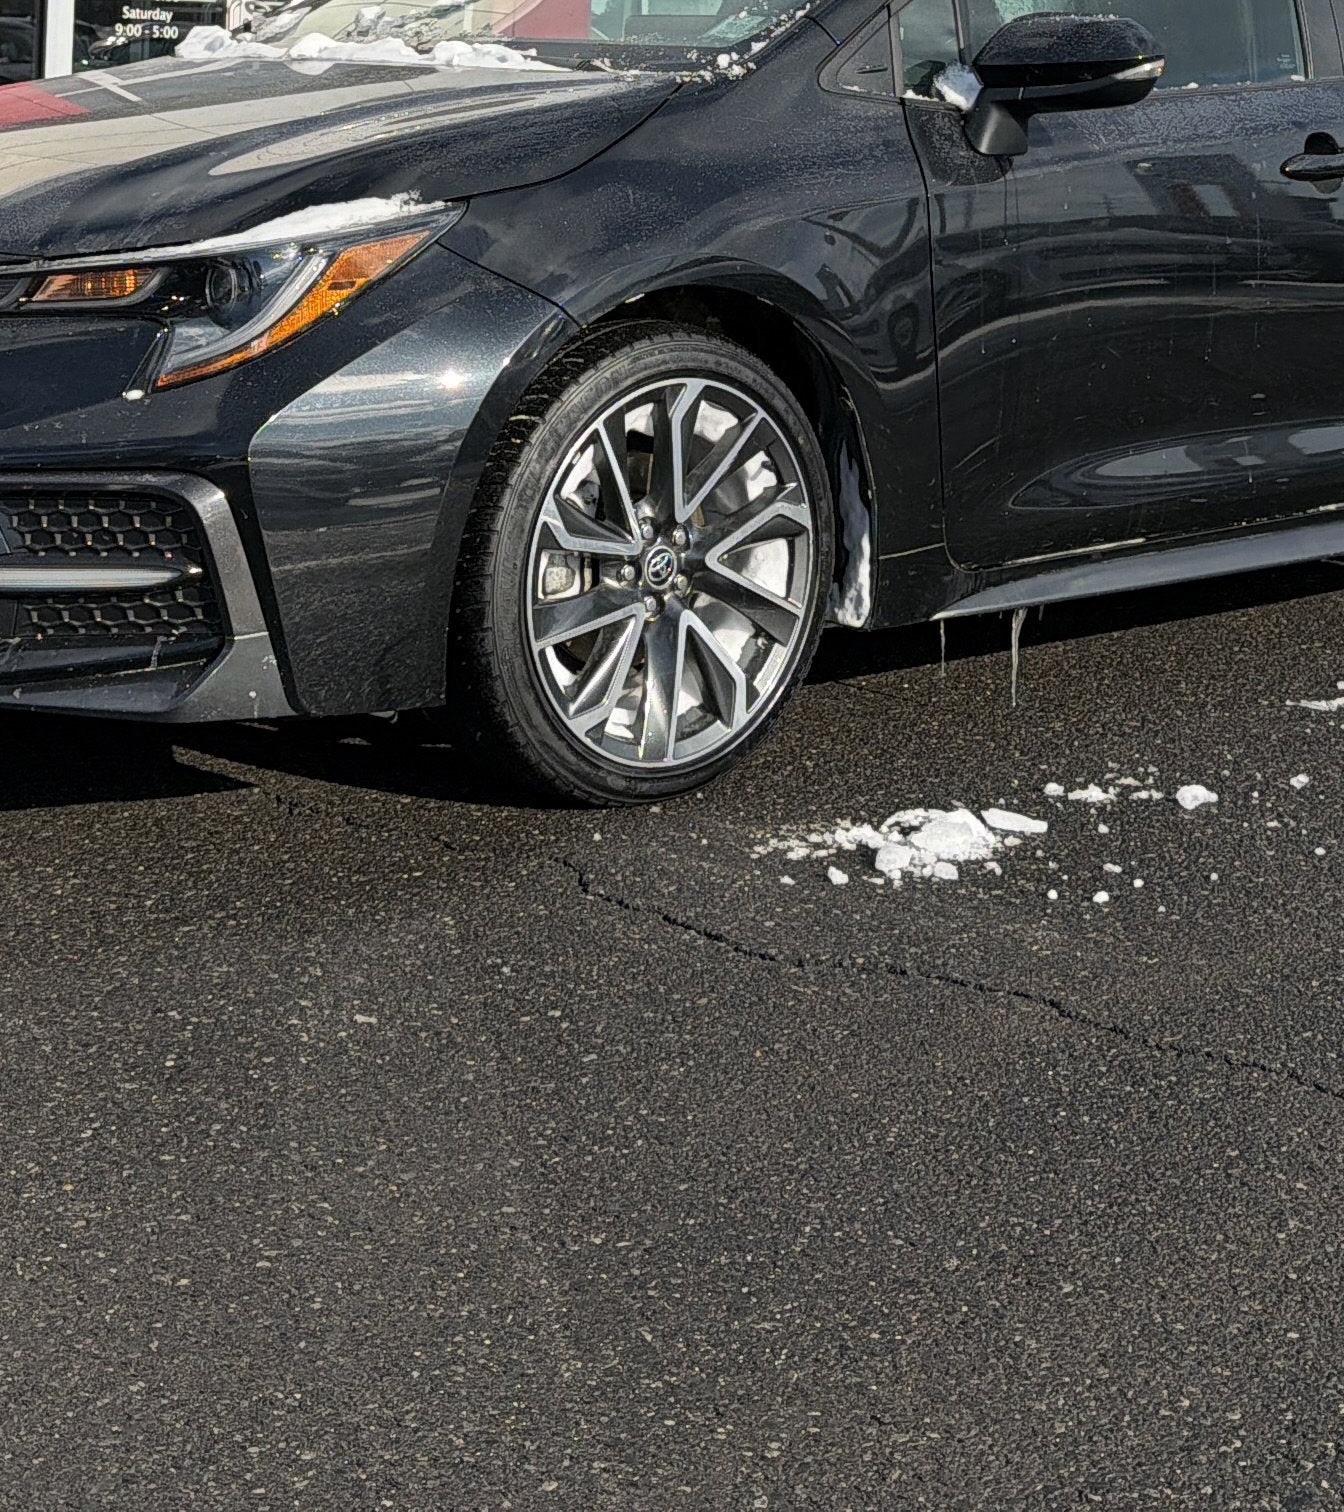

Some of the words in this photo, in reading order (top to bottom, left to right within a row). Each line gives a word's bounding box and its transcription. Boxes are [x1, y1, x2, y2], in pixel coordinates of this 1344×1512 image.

[122, 5, 174, 23] Saturday
[115, 23, 142, 37] 9:00
[152, 25, 179, 39] 5:00
